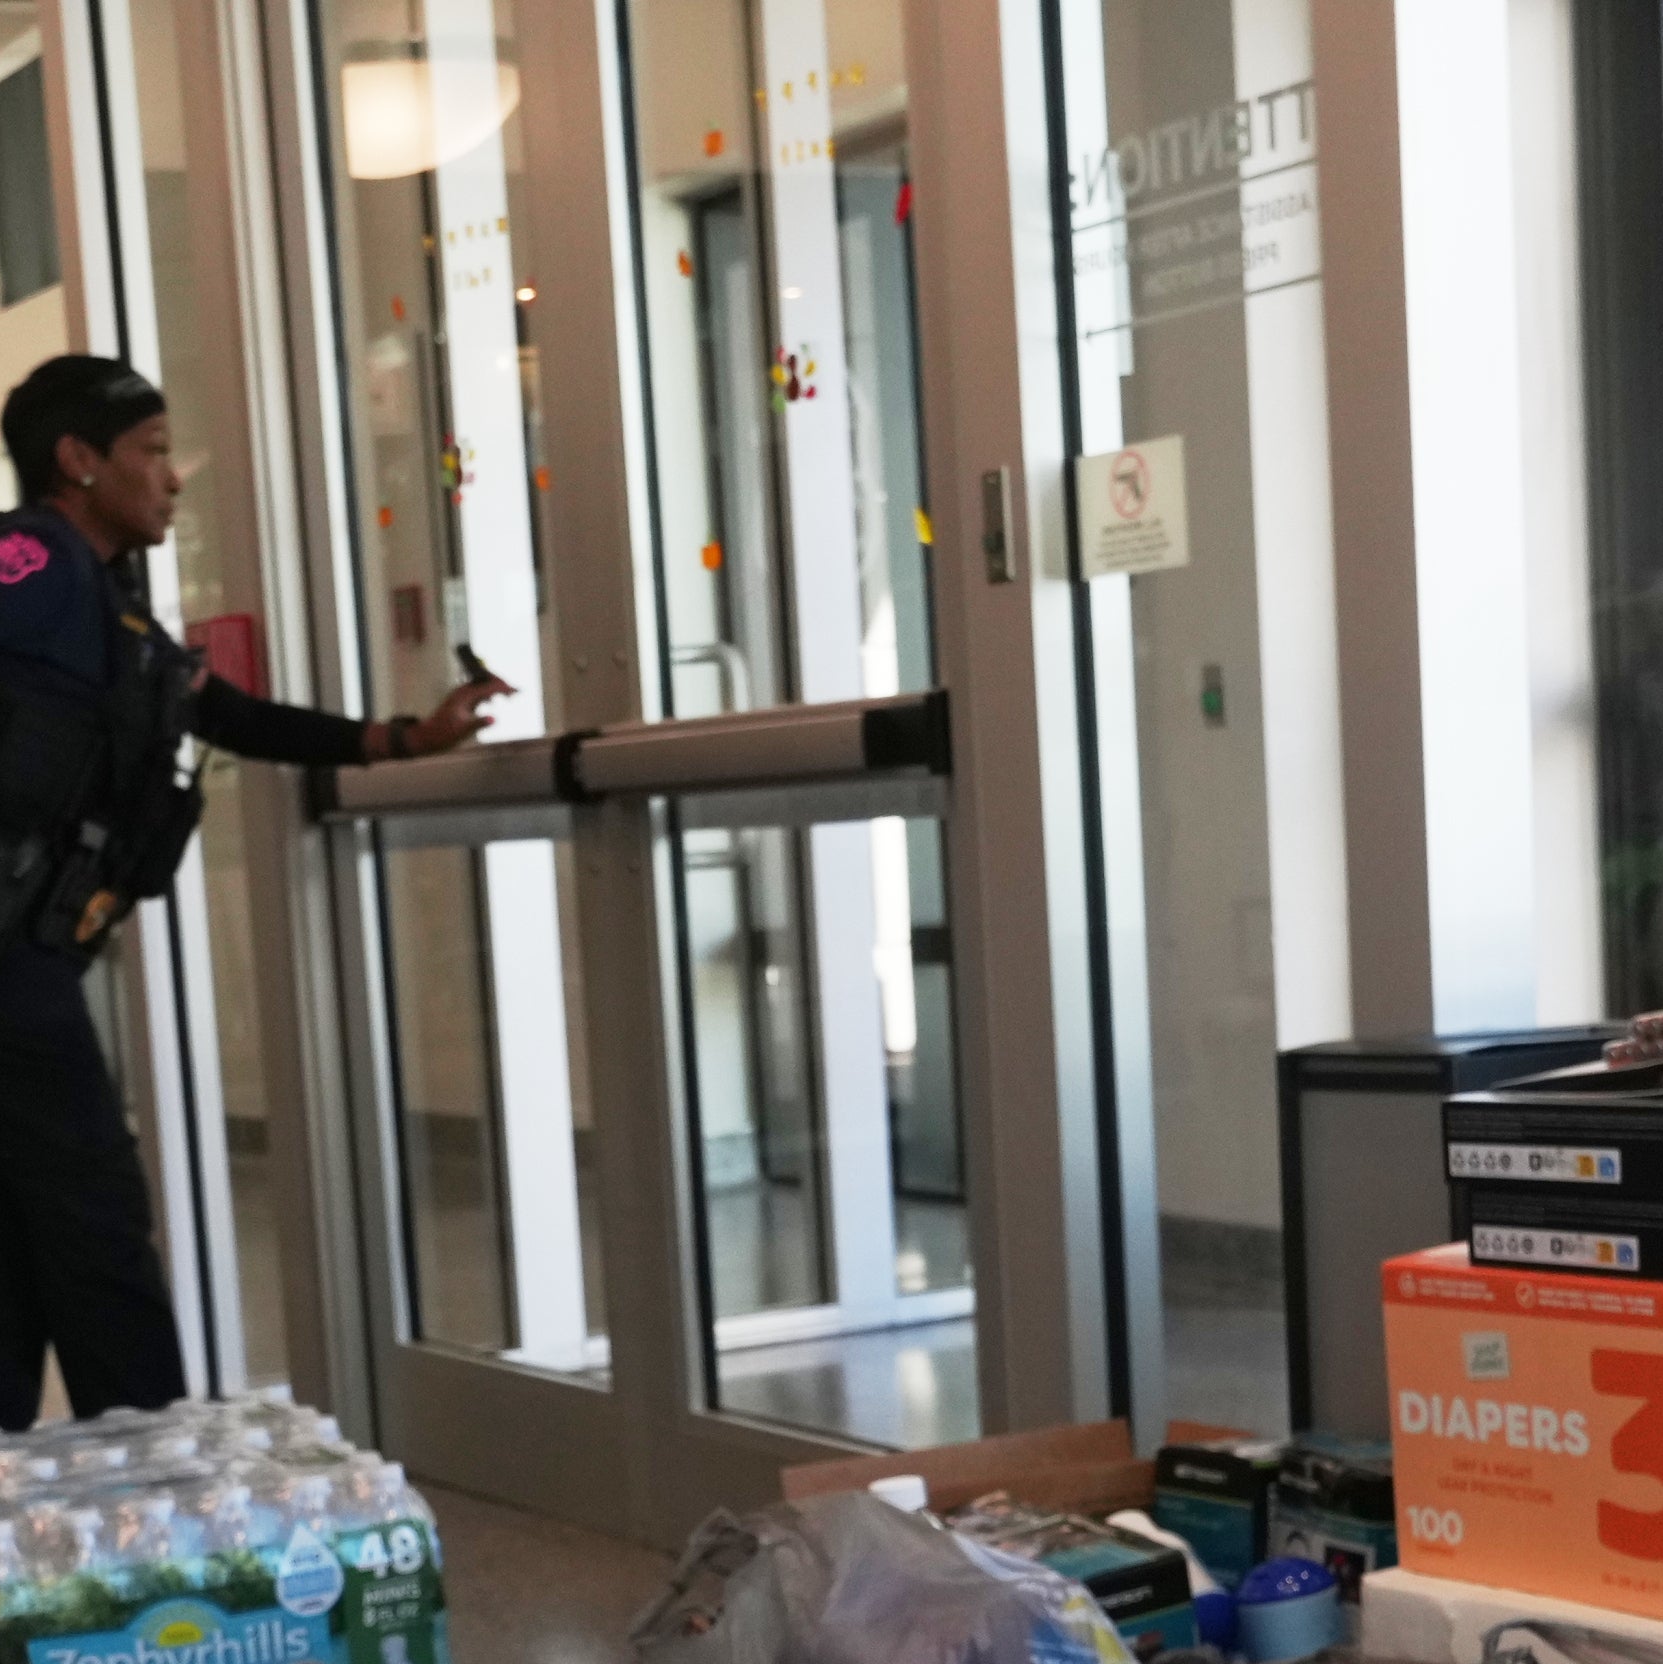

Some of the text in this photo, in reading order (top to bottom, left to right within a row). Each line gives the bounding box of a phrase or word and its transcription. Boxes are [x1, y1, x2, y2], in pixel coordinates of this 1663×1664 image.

[1398, 1389, 1589, 1457] DIAPERS
[356, 1525, 425, 1578] 48
[1406, 1505, 1464, 1545] 100
